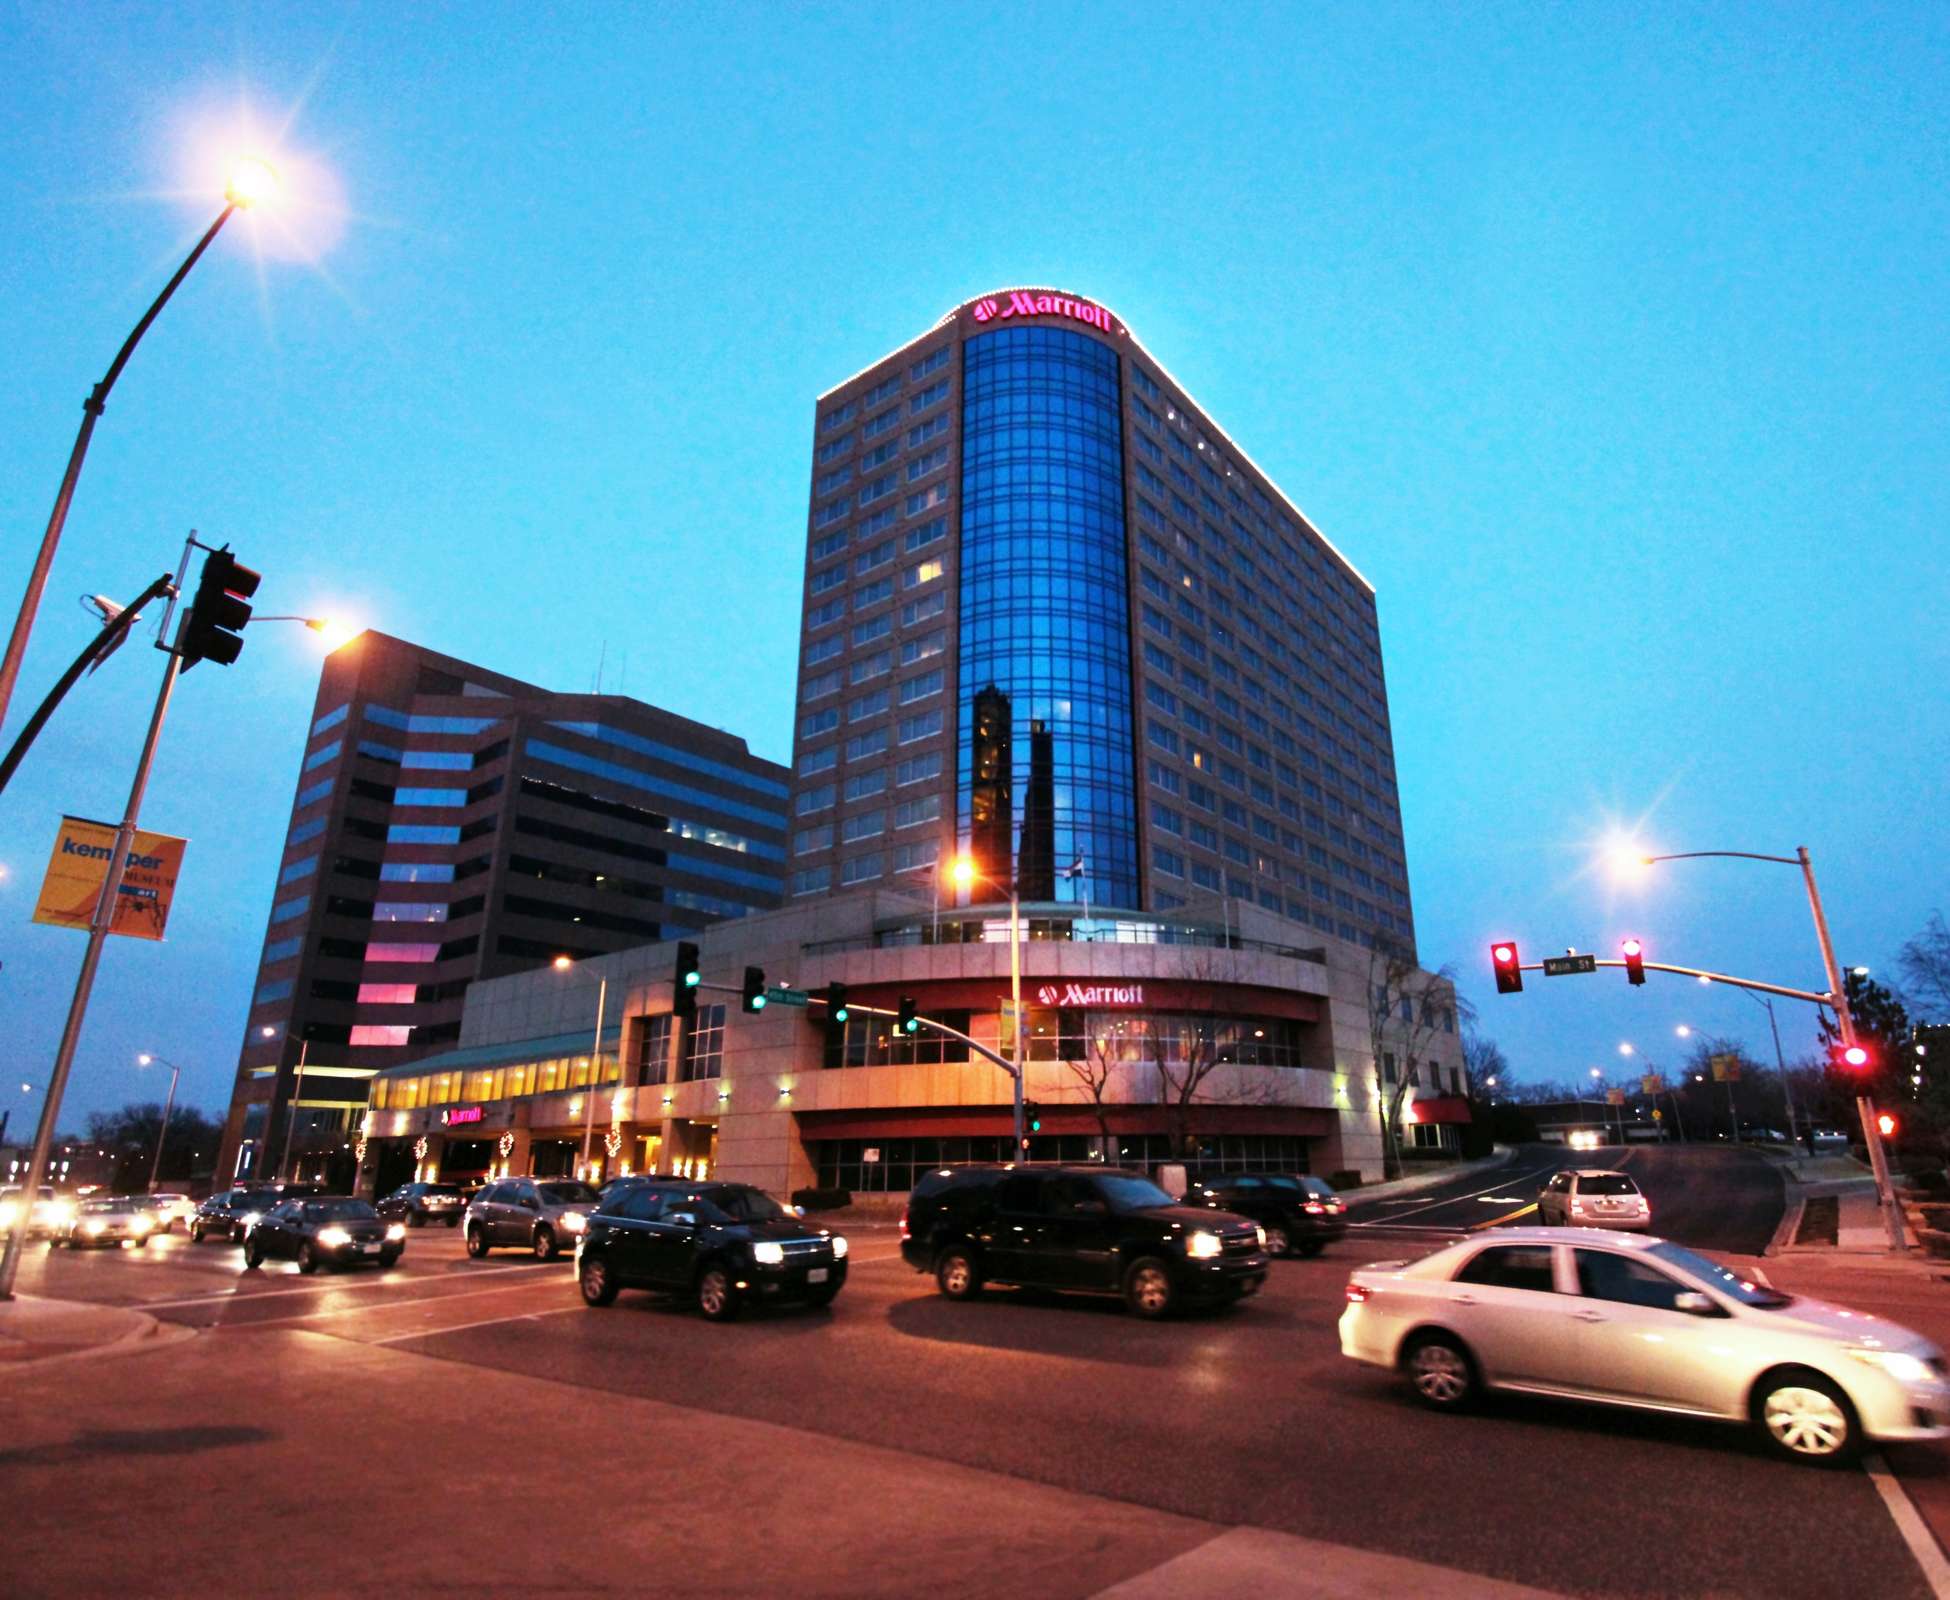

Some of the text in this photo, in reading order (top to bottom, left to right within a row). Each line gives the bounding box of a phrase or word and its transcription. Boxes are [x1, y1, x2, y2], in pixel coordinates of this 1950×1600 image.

[1000, 292, 1112, 332] Marriott
[1579, 959, 1590, 969] St
[1060, 984, 1143, 1006] Marriott
